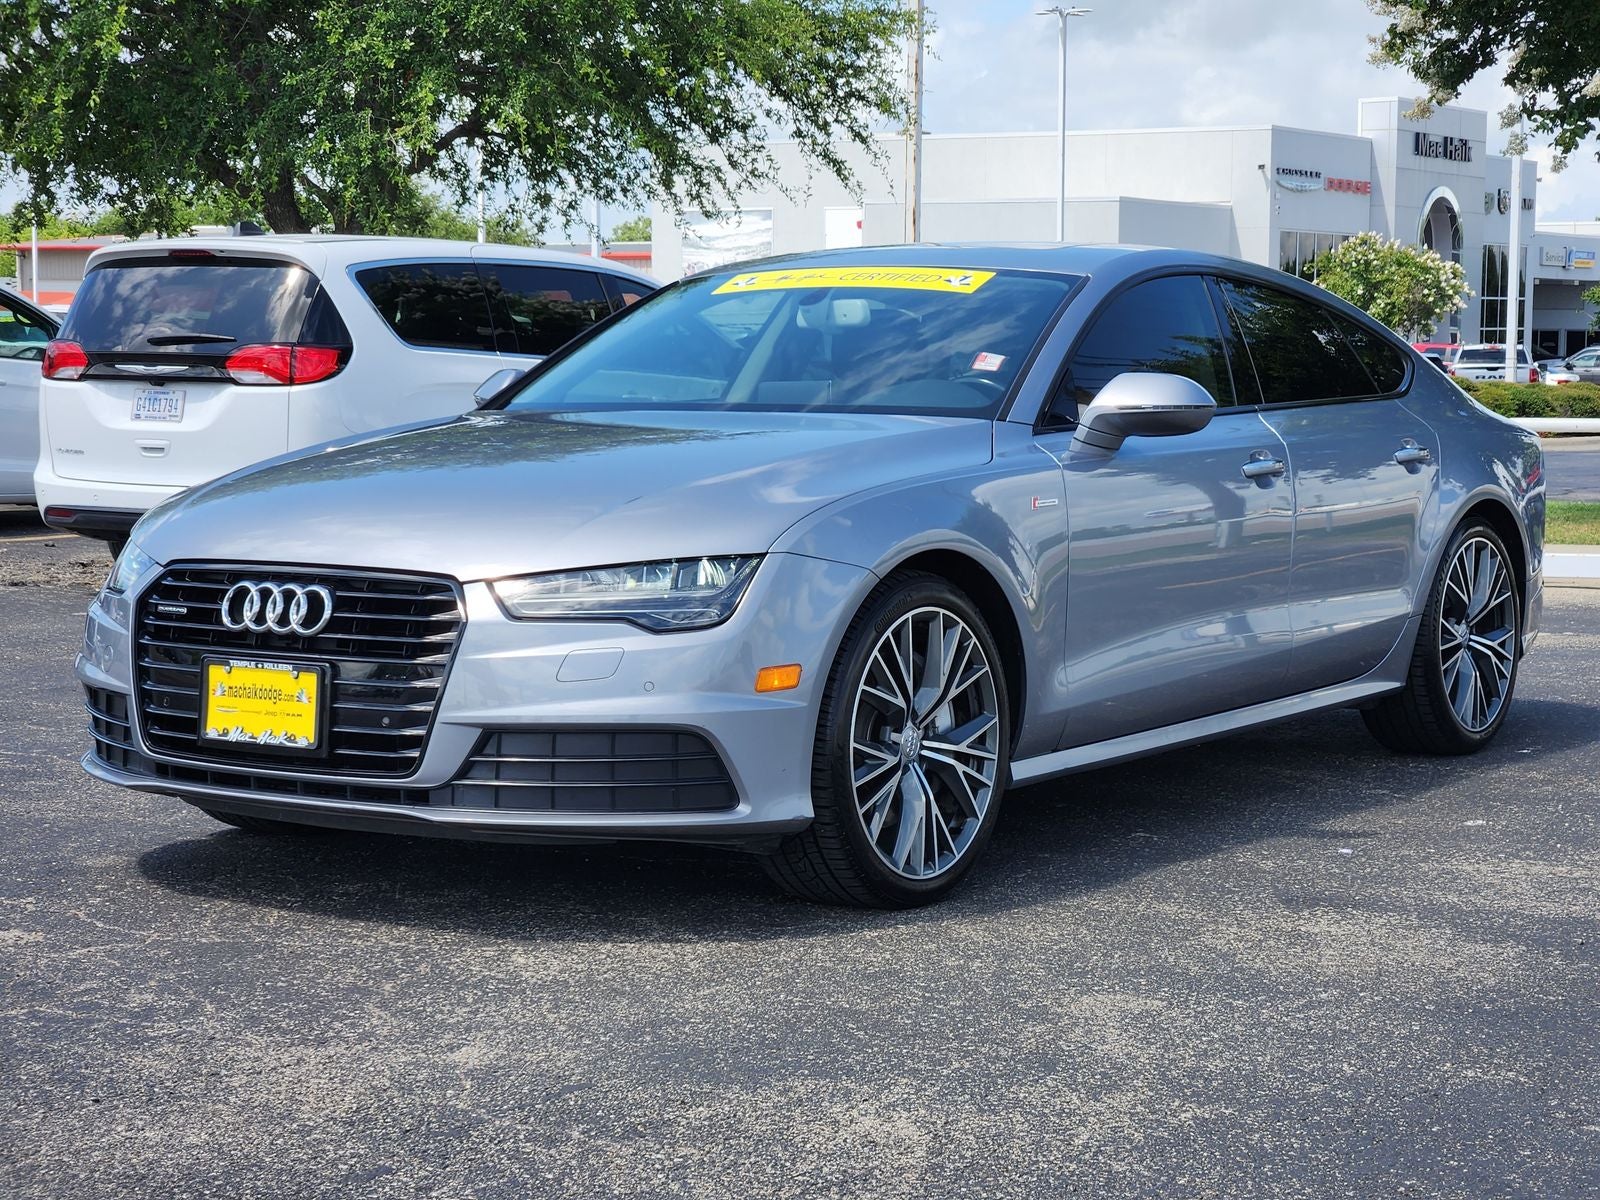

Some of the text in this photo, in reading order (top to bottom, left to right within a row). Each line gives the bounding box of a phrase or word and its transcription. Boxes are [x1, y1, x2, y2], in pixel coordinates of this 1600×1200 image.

[1414, 132, 1473, 162] Mac Haik
[1324, 177, 1371, 196] DODGE
[1545, 251, 1564, 263] Service
[839, 272, 942, 283] CERTIFIED
[136, 397, 179, 413] G41C1794
[229, 660, 293, 671] TEMPLE KILLEEN
[227, 683, 294, 704] machaikdodge.com
[228, 726, 289, 744] Mac Haik
